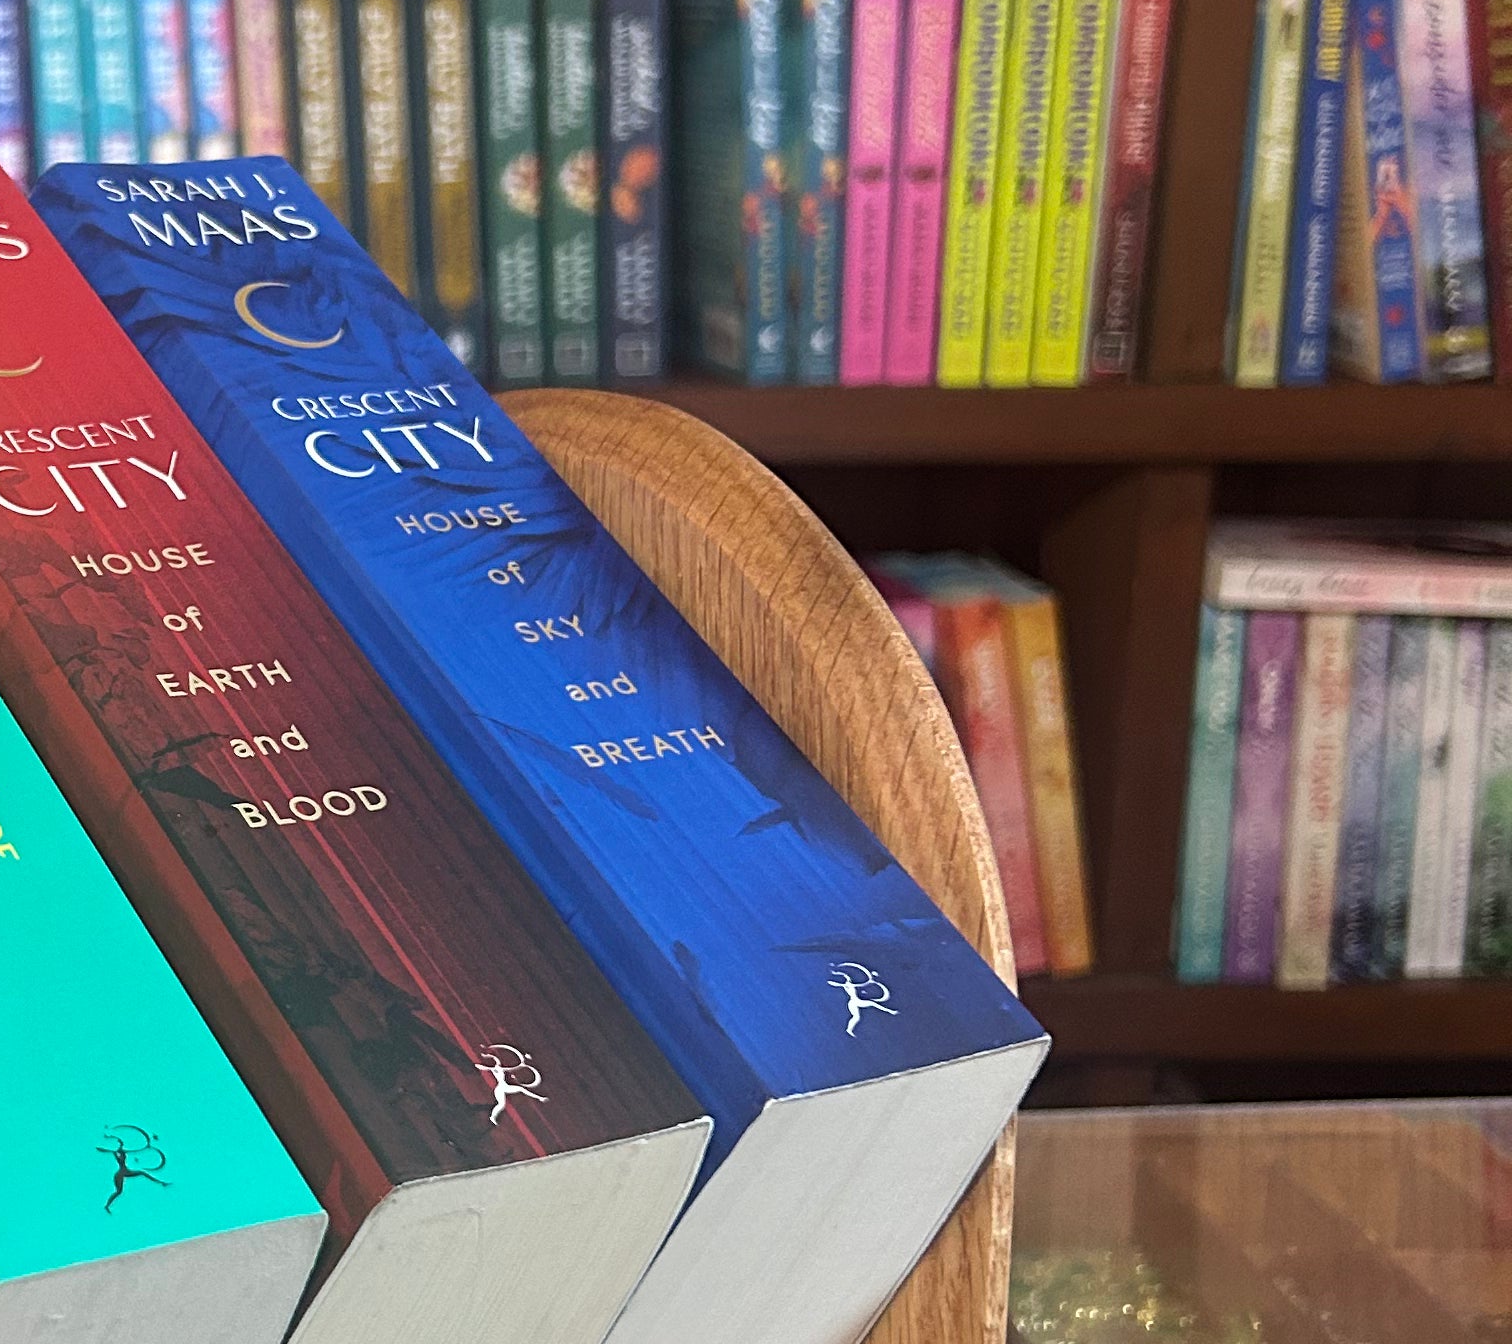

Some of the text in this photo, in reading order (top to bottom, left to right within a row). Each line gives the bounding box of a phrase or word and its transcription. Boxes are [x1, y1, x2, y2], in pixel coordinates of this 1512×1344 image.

[97, 172, 286, 204] SARAH J.
[128, 206, 319, 248] MAAS
[272, 384, 459, 423] CRESCENT
[303, 416, 495, 478] CITY
[394, 502, 527, 536] HOUSE
[71, 543, 215, 578] HOUSE
[488, 560, 527, 585] of
[162, 605, 203, 632] of
[513, 613, 587, 644] SKY
[156, 659, 292, 699] EARTH
[565, 672, 638, 702] and
[229, 724, 309, 759] and
[570, 724, 724, 770] BREATH
[231, 785, 387, 829] BLOOD
